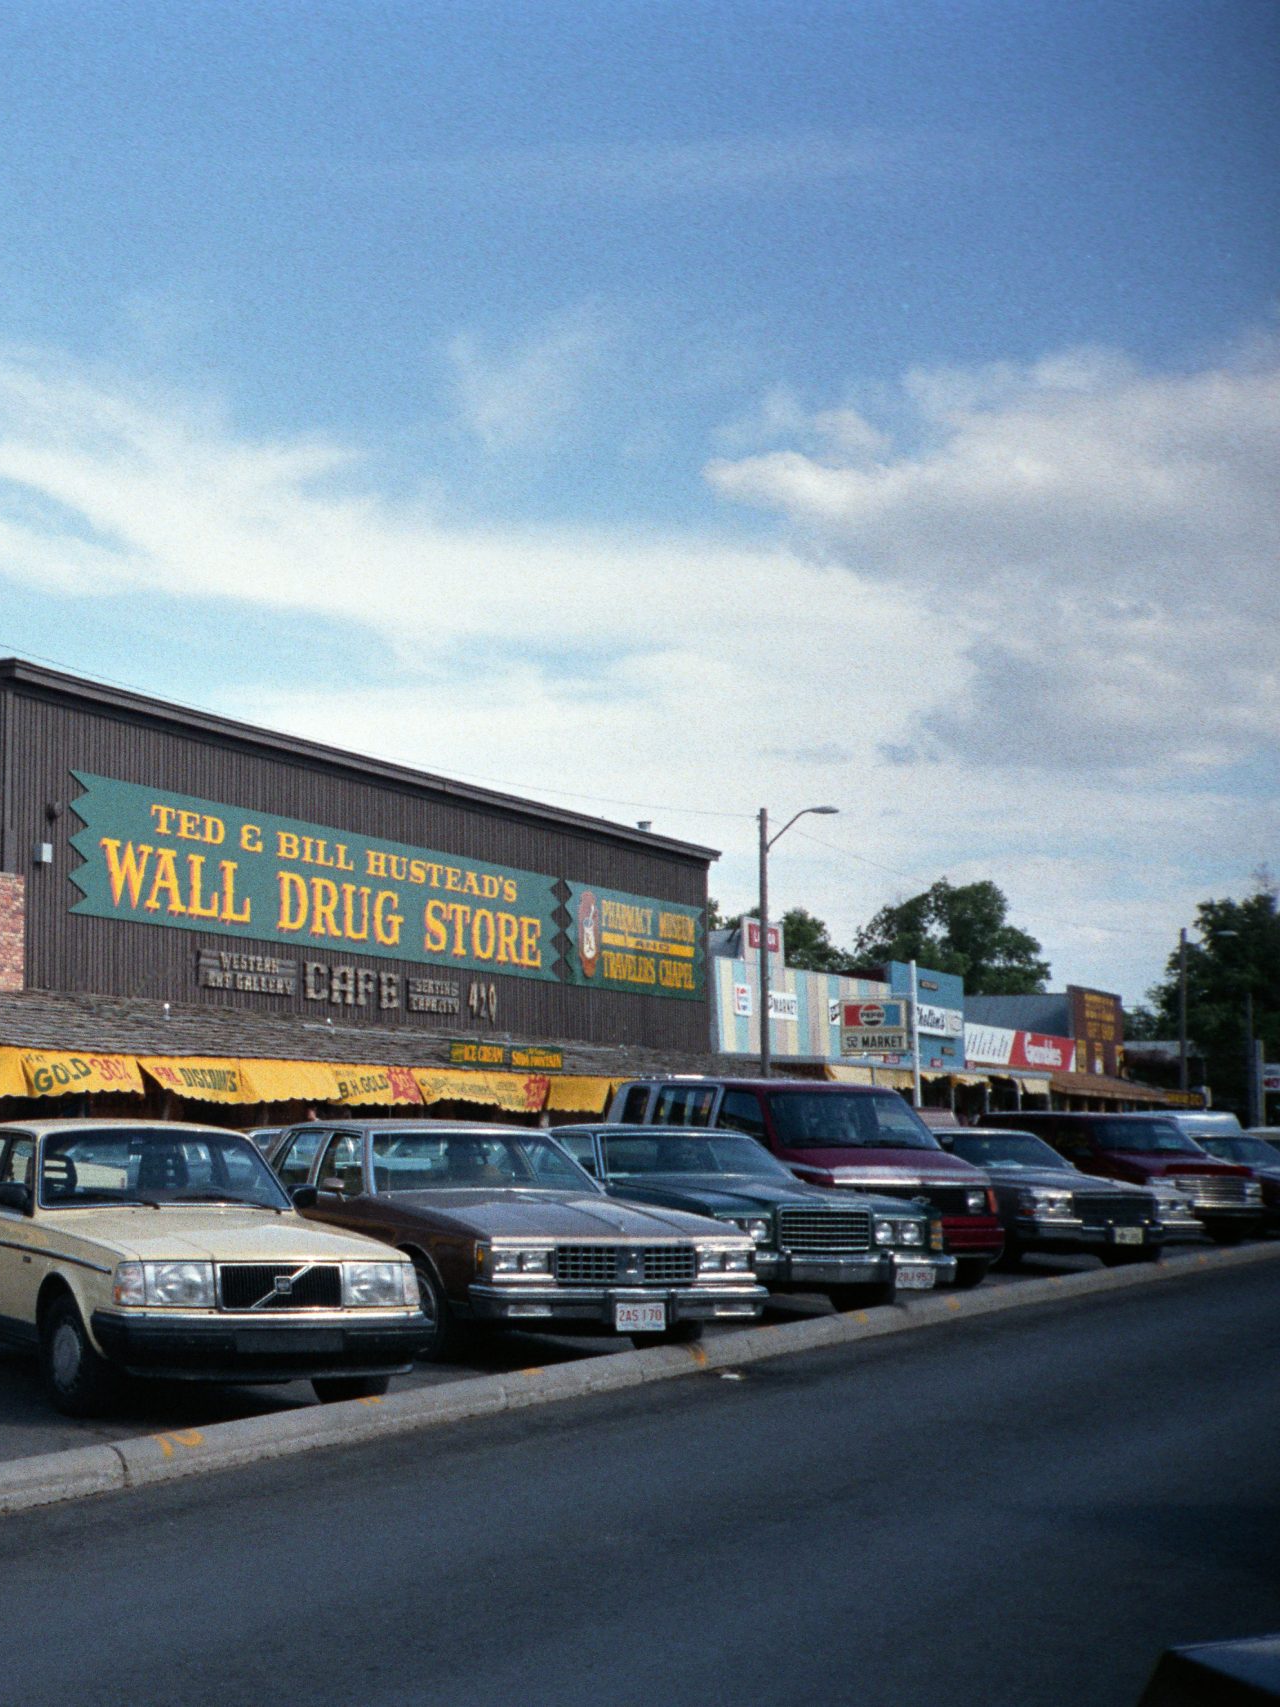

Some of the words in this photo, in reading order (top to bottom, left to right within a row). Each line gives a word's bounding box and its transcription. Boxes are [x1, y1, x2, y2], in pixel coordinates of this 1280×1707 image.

[151, 804, 225, 845] TED
[277, 831, 354, 871] BILL
[366, 849, 517, 903] HUSTEAD'S
[100, 837, 250, 925] WALL
[277, 870, 404, 946] DRUG
[424, 898, 541, 968] STORE
[220, 951, 280, 973] WESTERN
[237, 972, 293, 995] GALLERY
[304, 961, 400, 1009] CAFE
[861, 1011, 885, 1019] PEPSI
[862, 1036, 903, 1048] MARKET
[34, 1058, 92, 1092] GOLD
[178, 1067, 238, 1092] DISCOUNTS
[360, 1073, 390, 1093] GOLD
